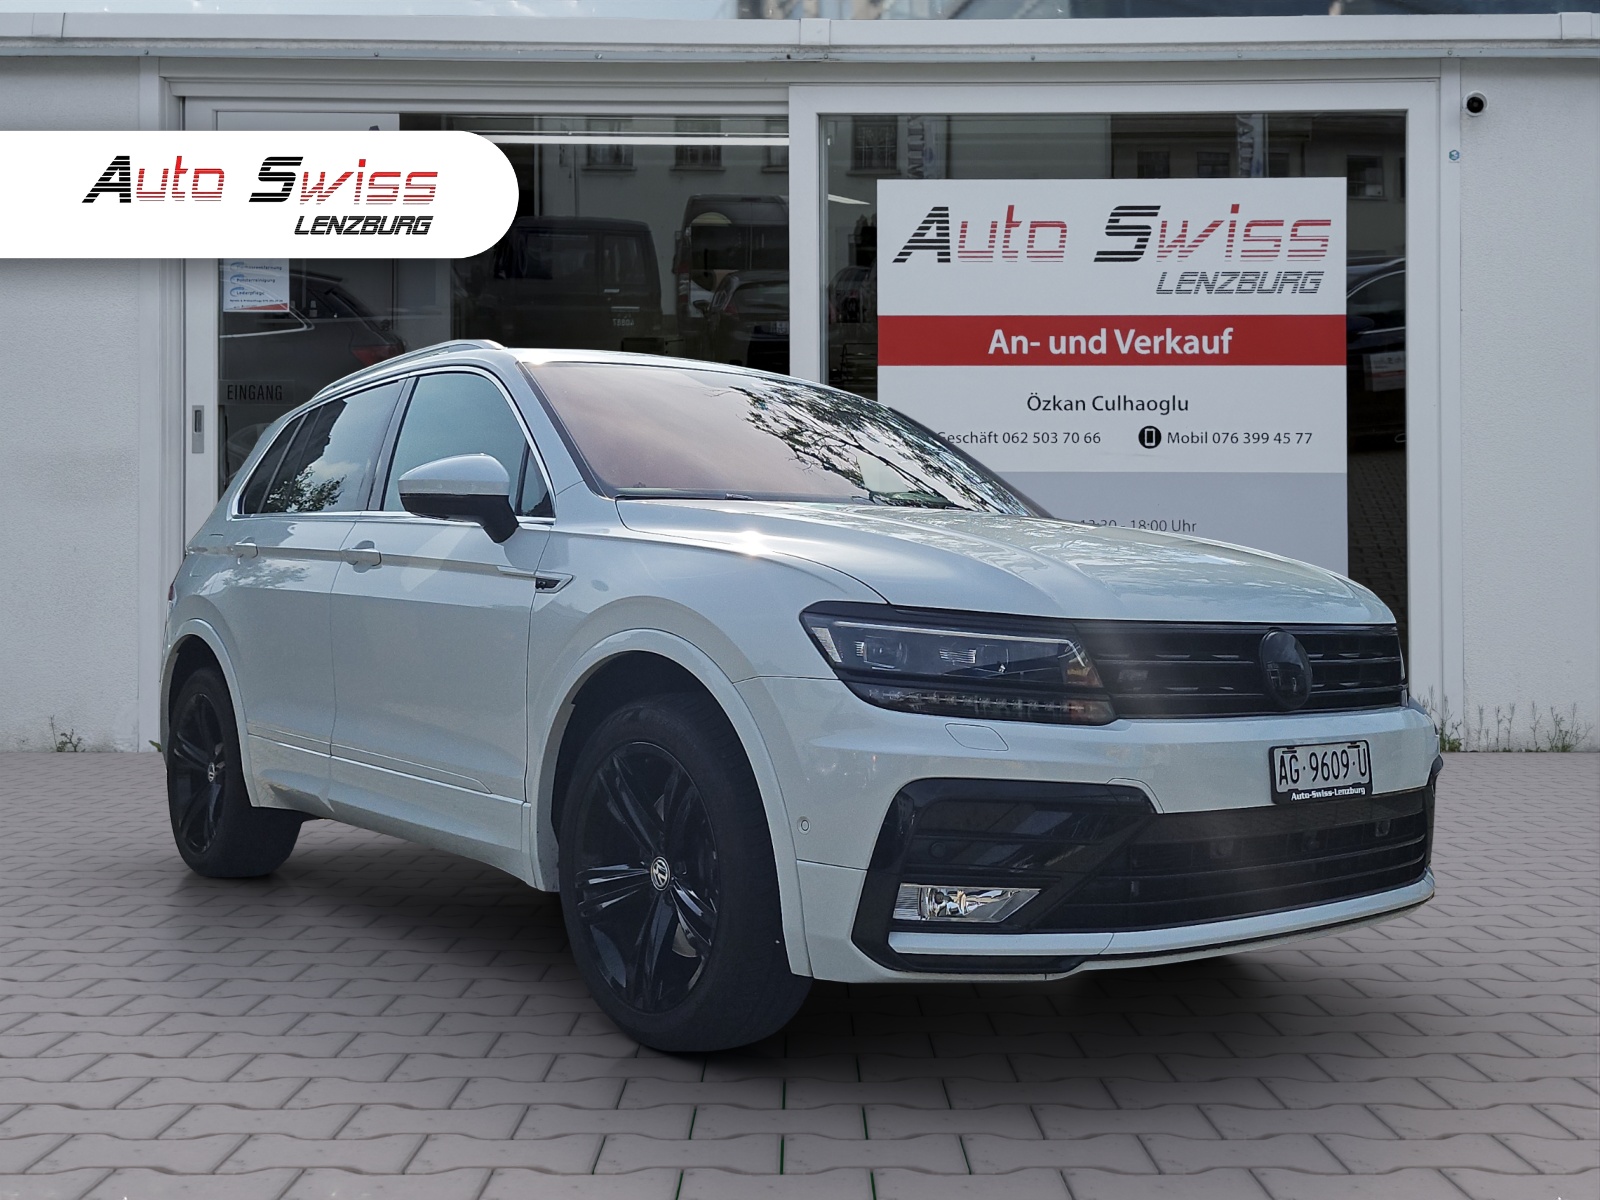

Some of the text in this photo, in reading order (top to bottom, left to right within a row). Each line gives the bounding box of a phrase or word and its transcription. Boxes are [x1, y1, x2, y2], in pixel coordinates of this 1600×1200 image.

[893, 203, 1332, 264] Auto Swiss
[1155, 271, 1325, 295] LENZBURG
[988, 327, 1234, 355] An- und Verkauf
[227, 384, 283, 401] EINGANG
[1026, 393, 1189, 416] Özkan Culhaoglu
[1002, 432, 1028, 444] 062
[1032, 432, 1058, 444] 503
[1062, 432, 1080, 444] 70
[1083, 432, 1101, 444] 66
[1167, 431, 1313, 444] Mobil 076 399 45 77
[1130, 519, 1167, 532] 18:00
[1171, 519, 1197, 532] Uhr
